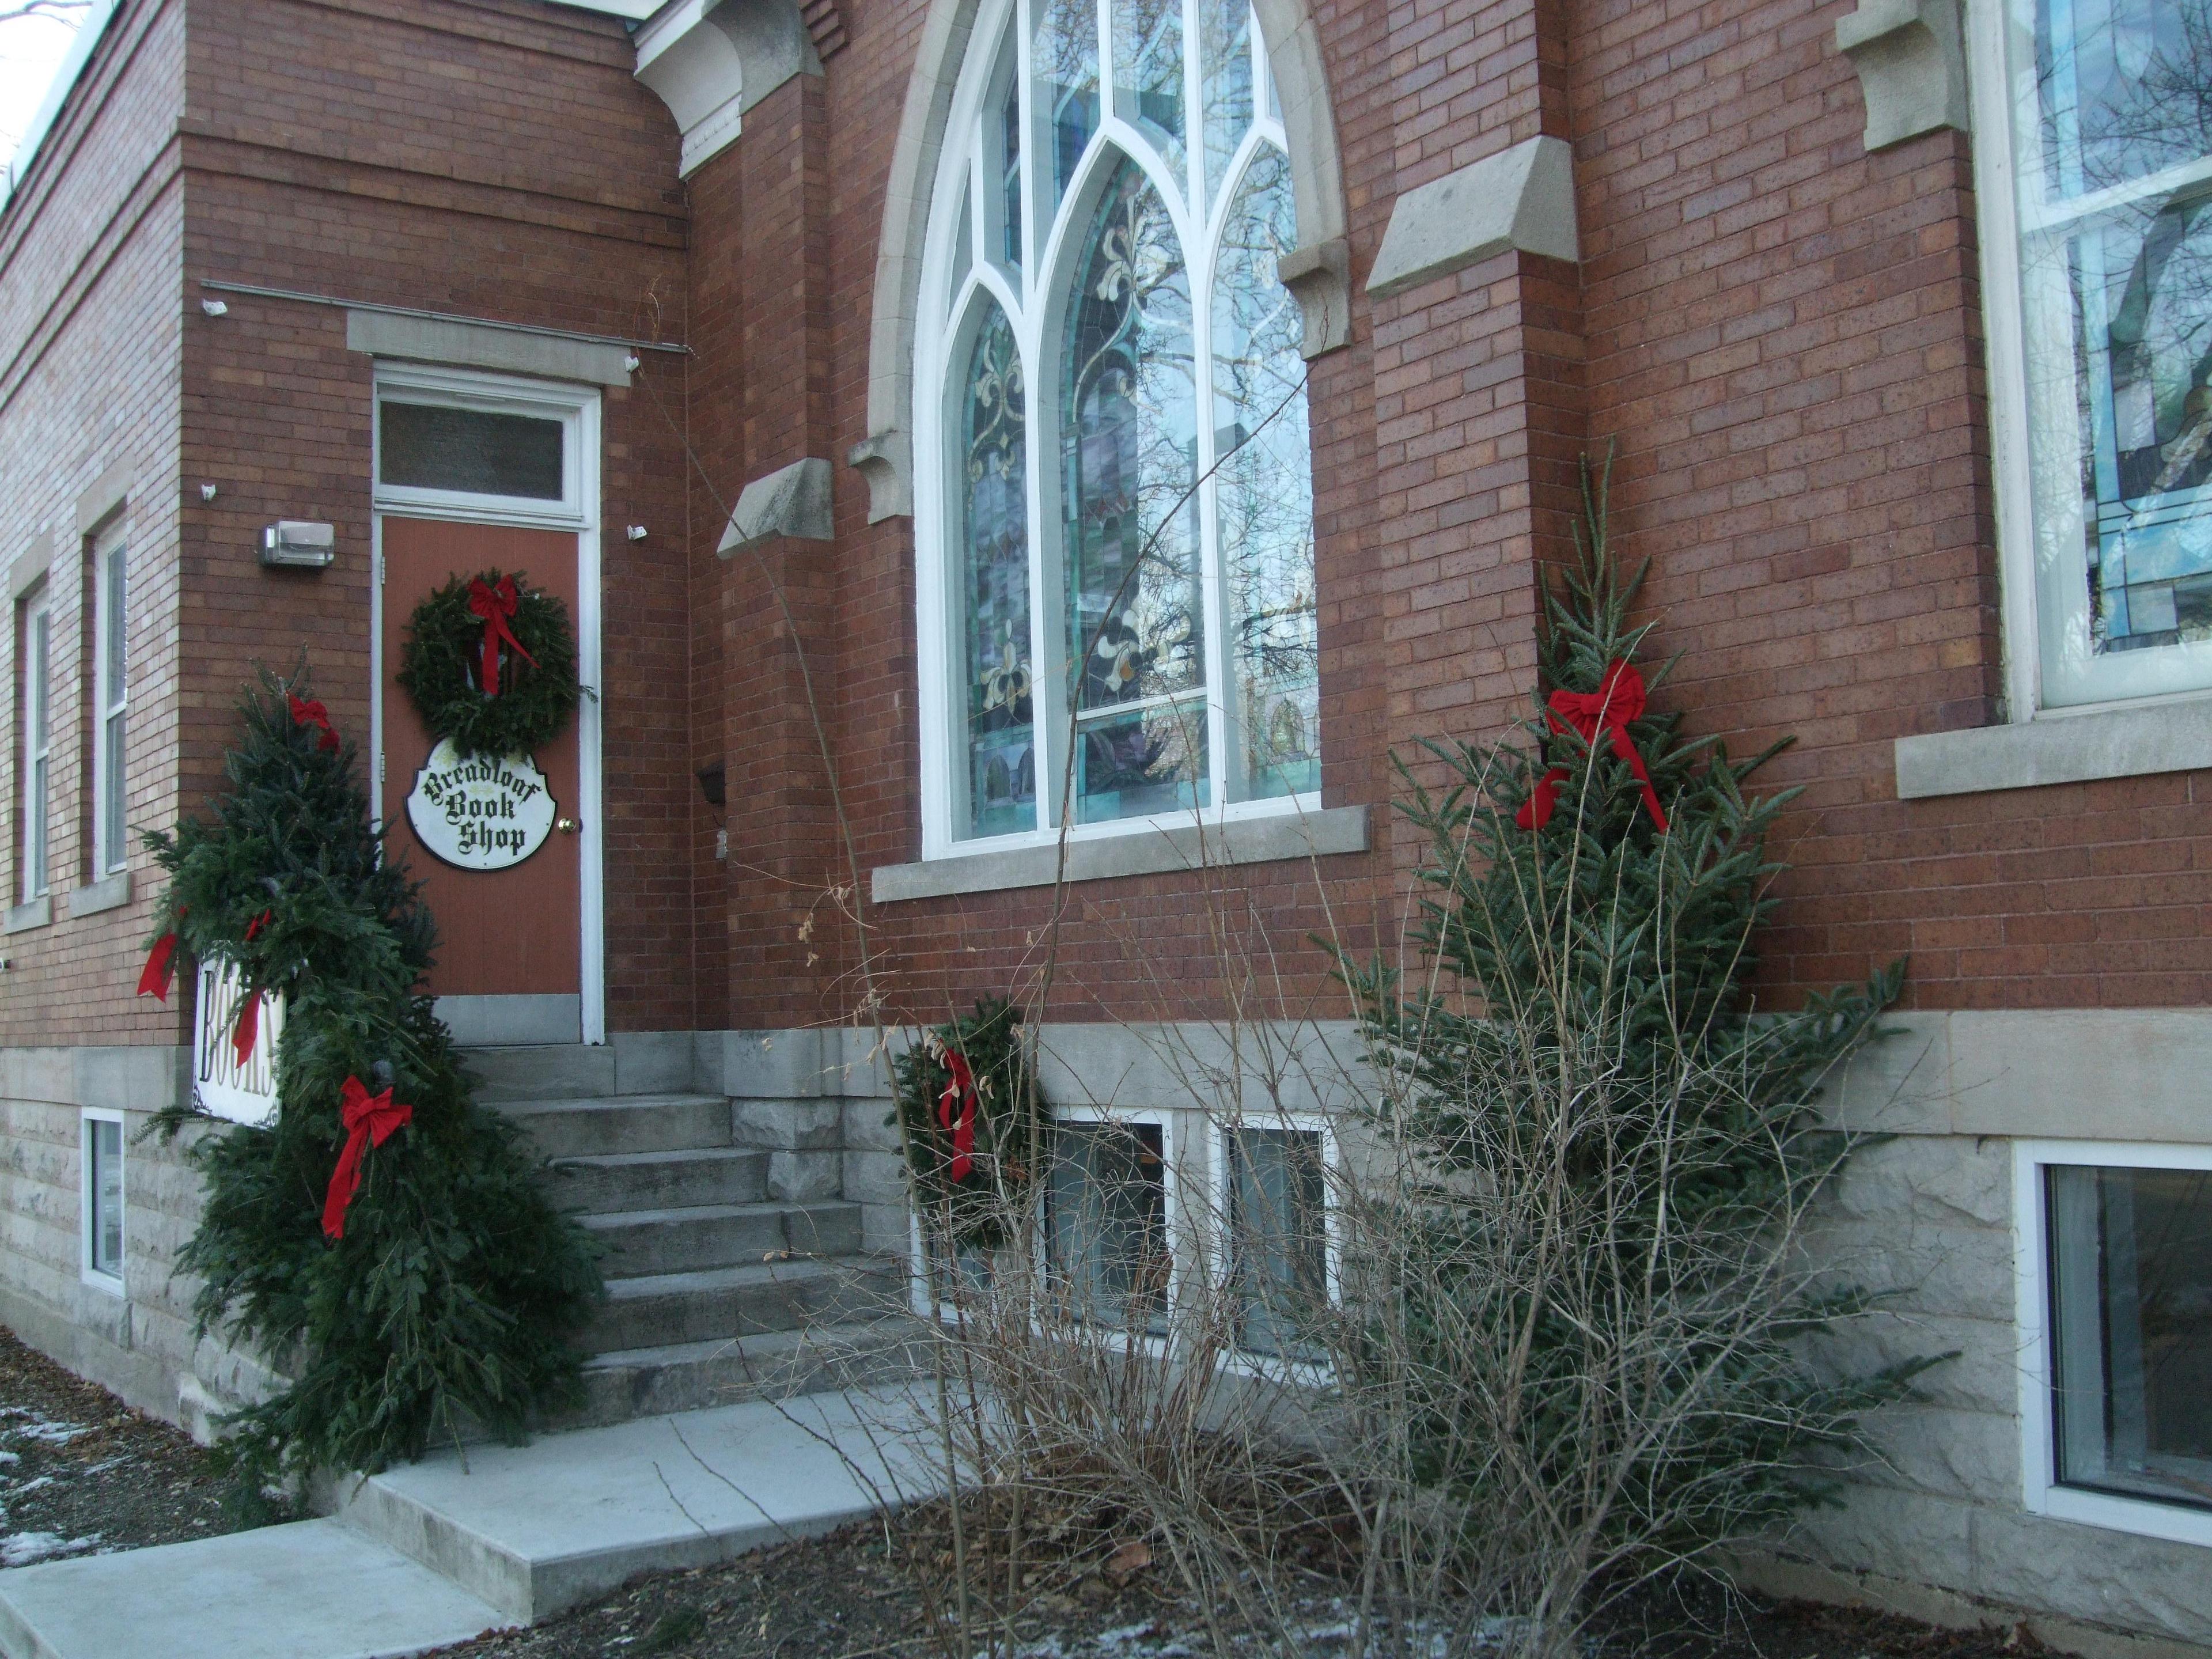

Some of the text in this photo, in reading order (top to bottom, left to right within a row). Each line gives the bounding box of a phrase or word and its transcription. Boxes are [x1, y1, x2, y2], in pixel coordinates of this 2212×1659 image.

[422, 759, 542, 805] Breadloaf
[445, 790, 516, 825] Book
[458, 820, 526, 856] Shop
